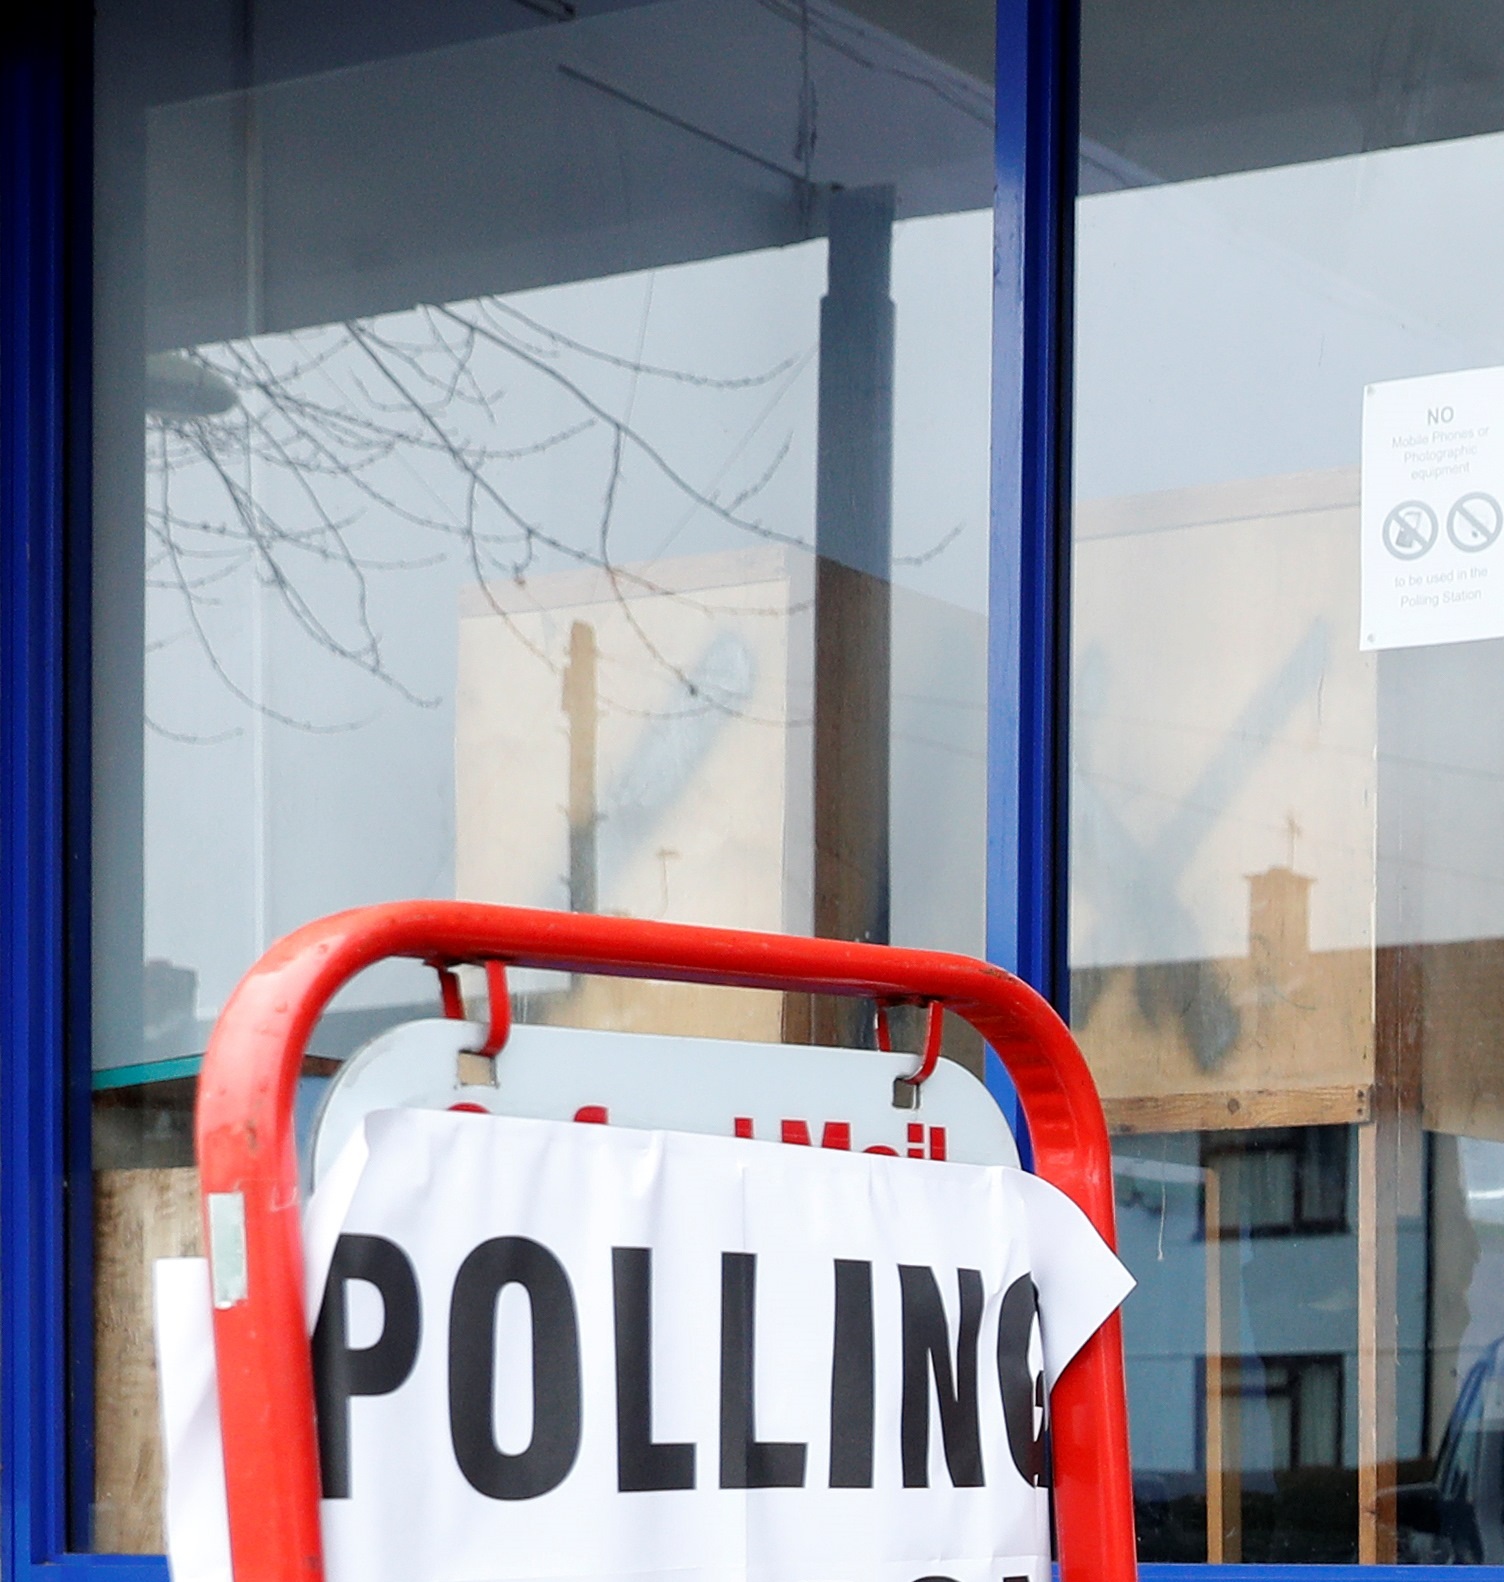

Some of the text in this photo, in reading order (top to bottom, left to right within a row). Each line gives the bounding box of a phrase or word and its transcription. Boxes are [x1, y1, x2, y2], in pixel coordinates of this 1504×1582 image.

[1427, 406, 1455, 426] NO
[1391, 426, 1490, 450] Mobile Phones or
[1403, 443, 1478, 464] Photographic
[1410, 461, 1471, 482] equipment
[1394, 566, 1489, 589] to be used in the
[1400, 588, 1483, 609] Polling Station
